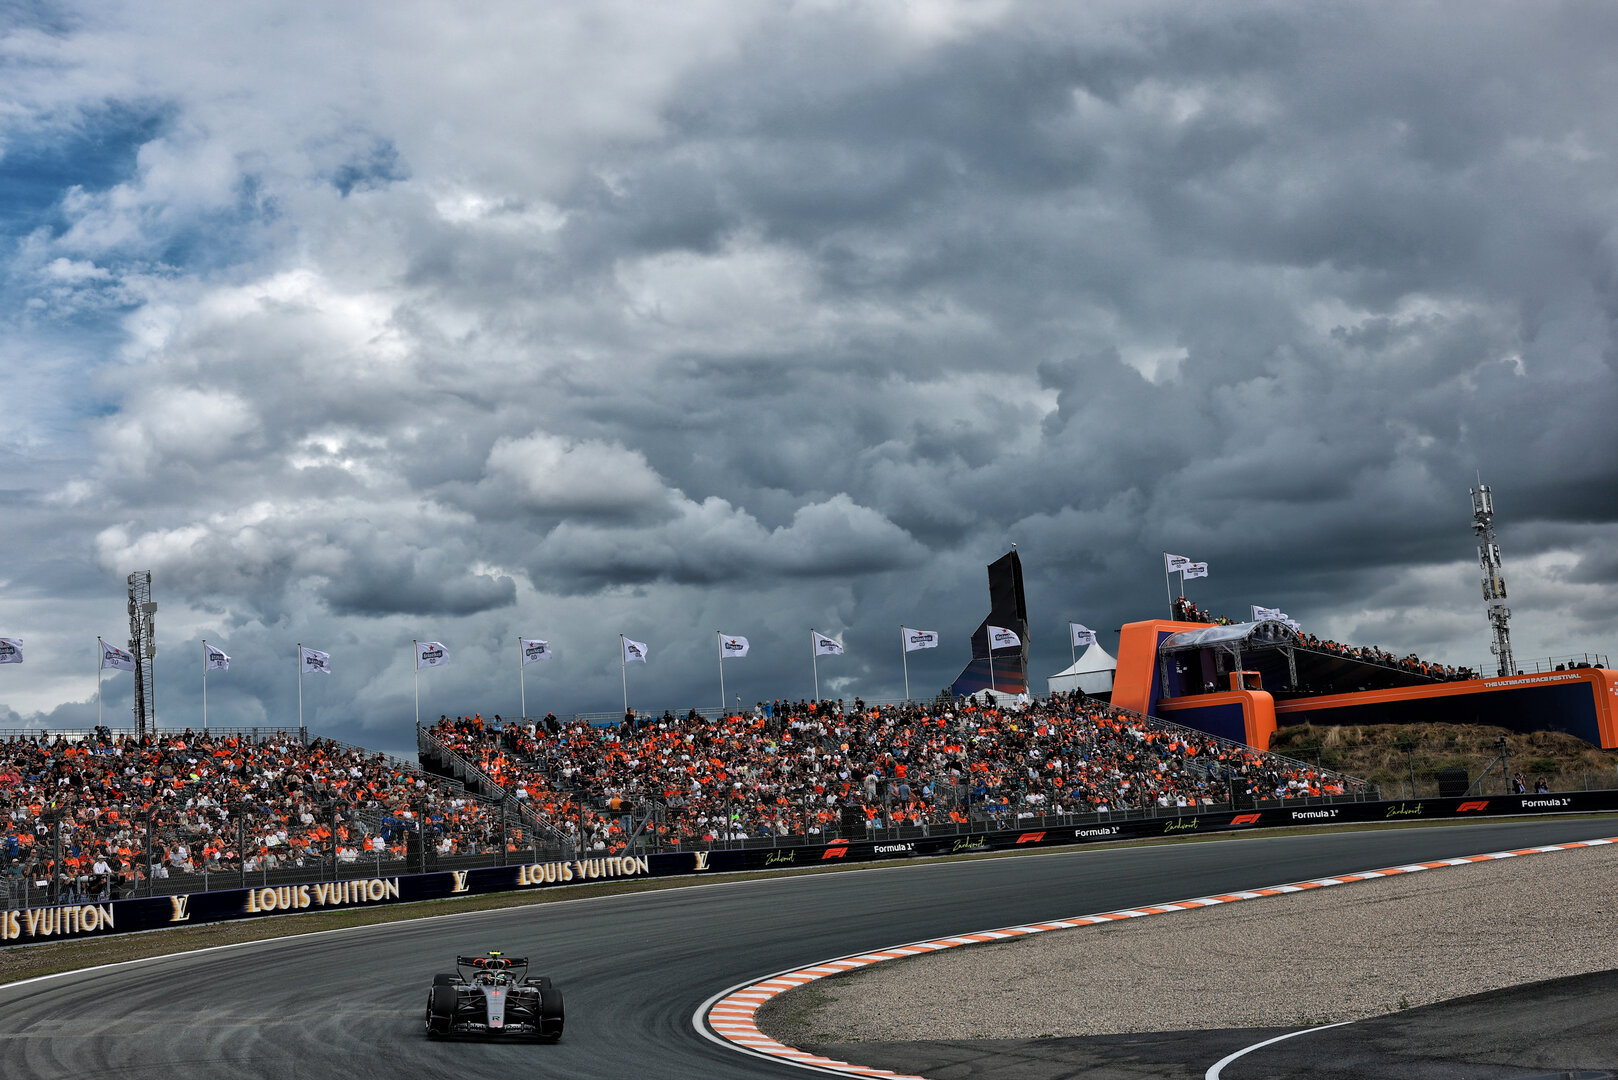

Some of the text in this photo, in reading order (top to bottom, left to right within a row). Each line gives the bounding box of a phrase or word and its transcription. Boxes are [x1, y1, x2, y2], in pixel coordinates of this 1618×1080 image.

[1498, 678, 1530, 686] ULTIMATE
[1549, 673, 1581, 682] FESTIVAL
[1521, 798, 1561, 808] Formula
[1291, 810, 1329, 820] Formula
[1074, 827, 1111, 838] Formula
[873, 843, 907, 854] Formula
[519, 854, 650, 886] LOUIS VUITTON
[248, 876, 400, 913] LOUIS VUITTON
[26, 902, 115, 937] VUITTON
